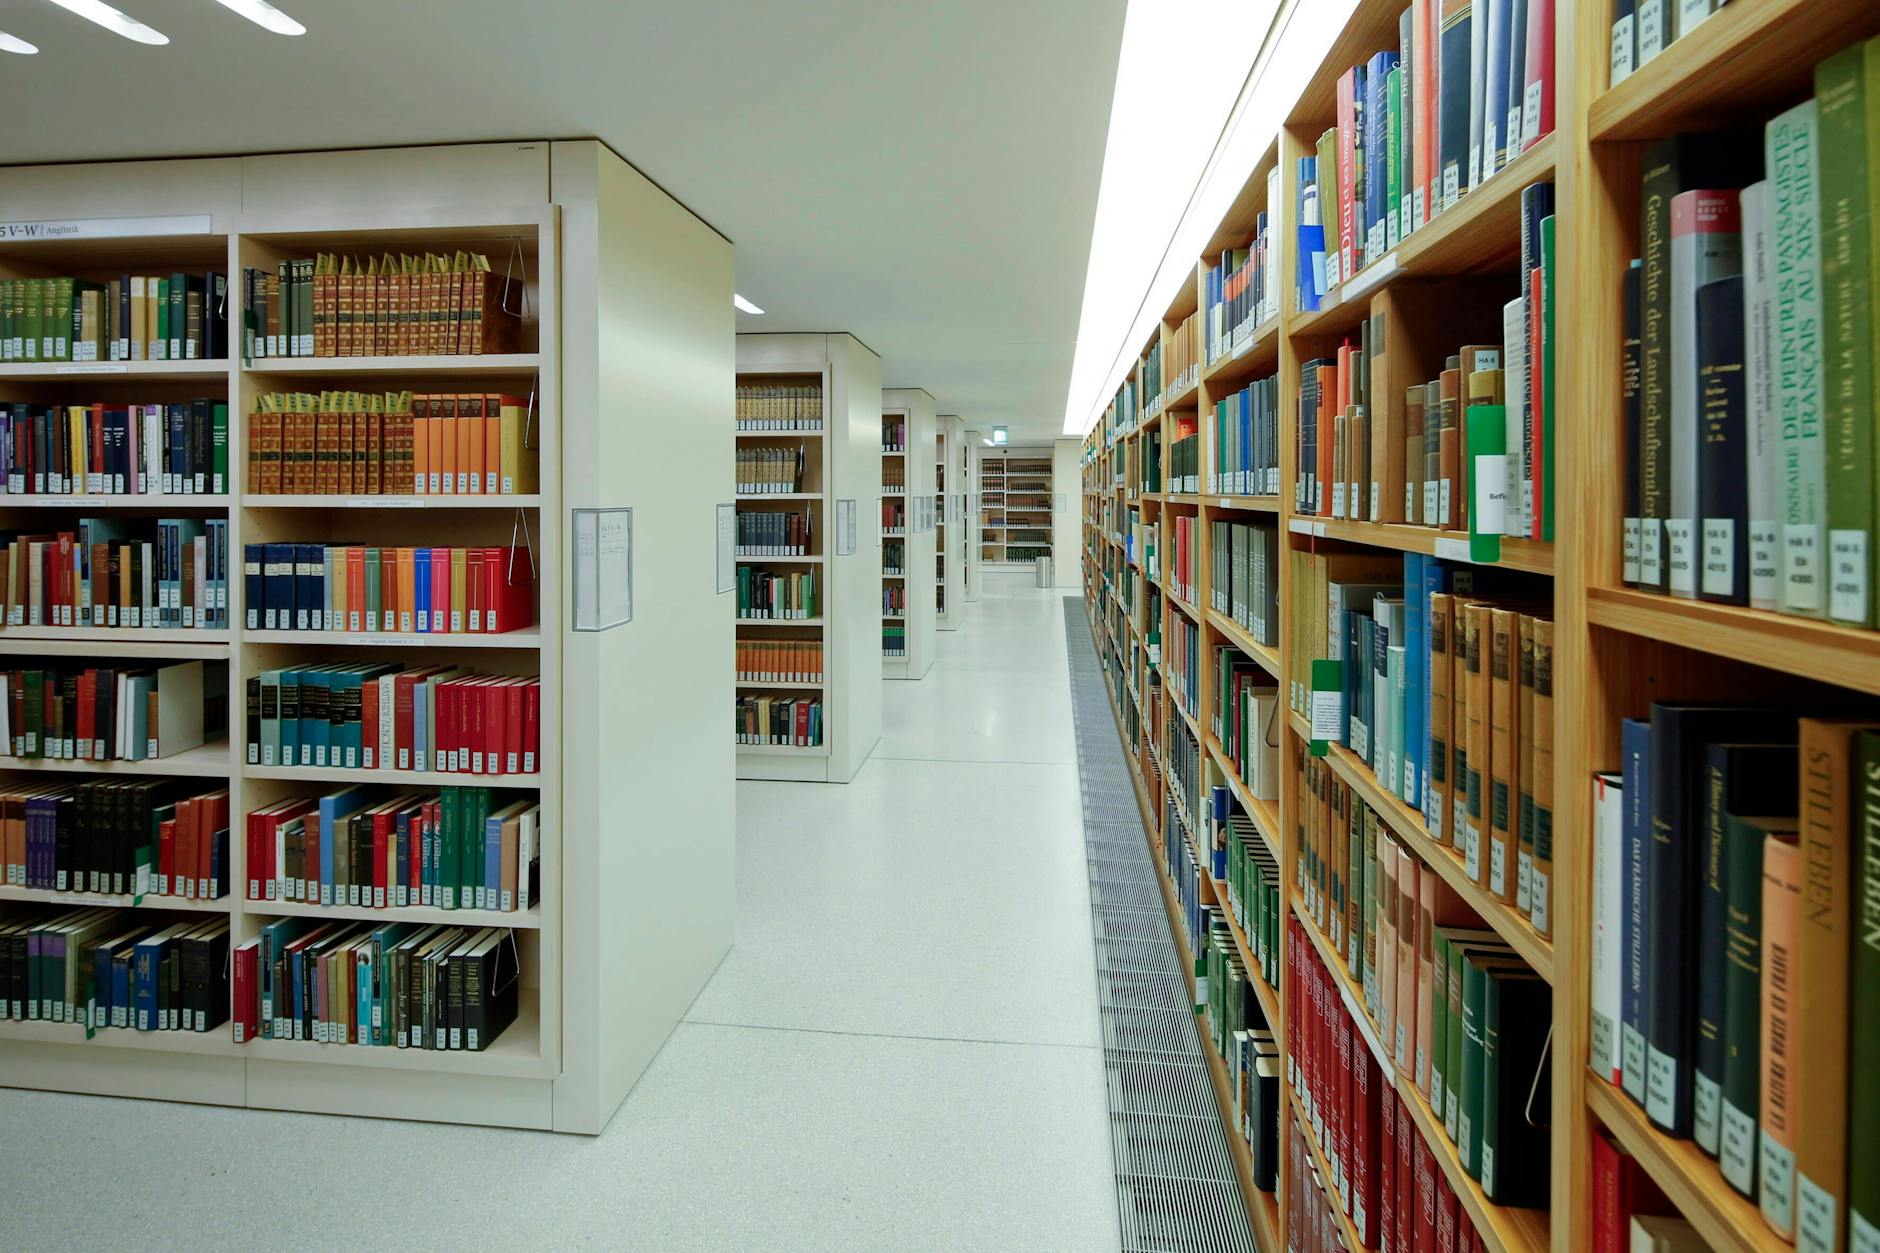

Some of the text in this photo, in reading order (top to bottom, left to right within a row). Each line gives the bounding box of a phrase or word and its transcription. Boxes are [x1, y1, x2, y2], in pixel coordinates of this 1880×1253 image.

[1647, 194, 1663, 302] Geschichte
[1774, 123, 1795, 274] PAYSAGISTES
[1647, 308, 1663, 342] der
[1776, 278, 1798, 389] PEINTRES
[1797, 269, 1815, 302] AU
[1782, 395, 1799, 441] DES
[1799, 318, 1819, 439] FRANÇAIS
[1631, 837, 1642, 861] DAS
[1807, 747, 1833, 933] STILLEBEN
